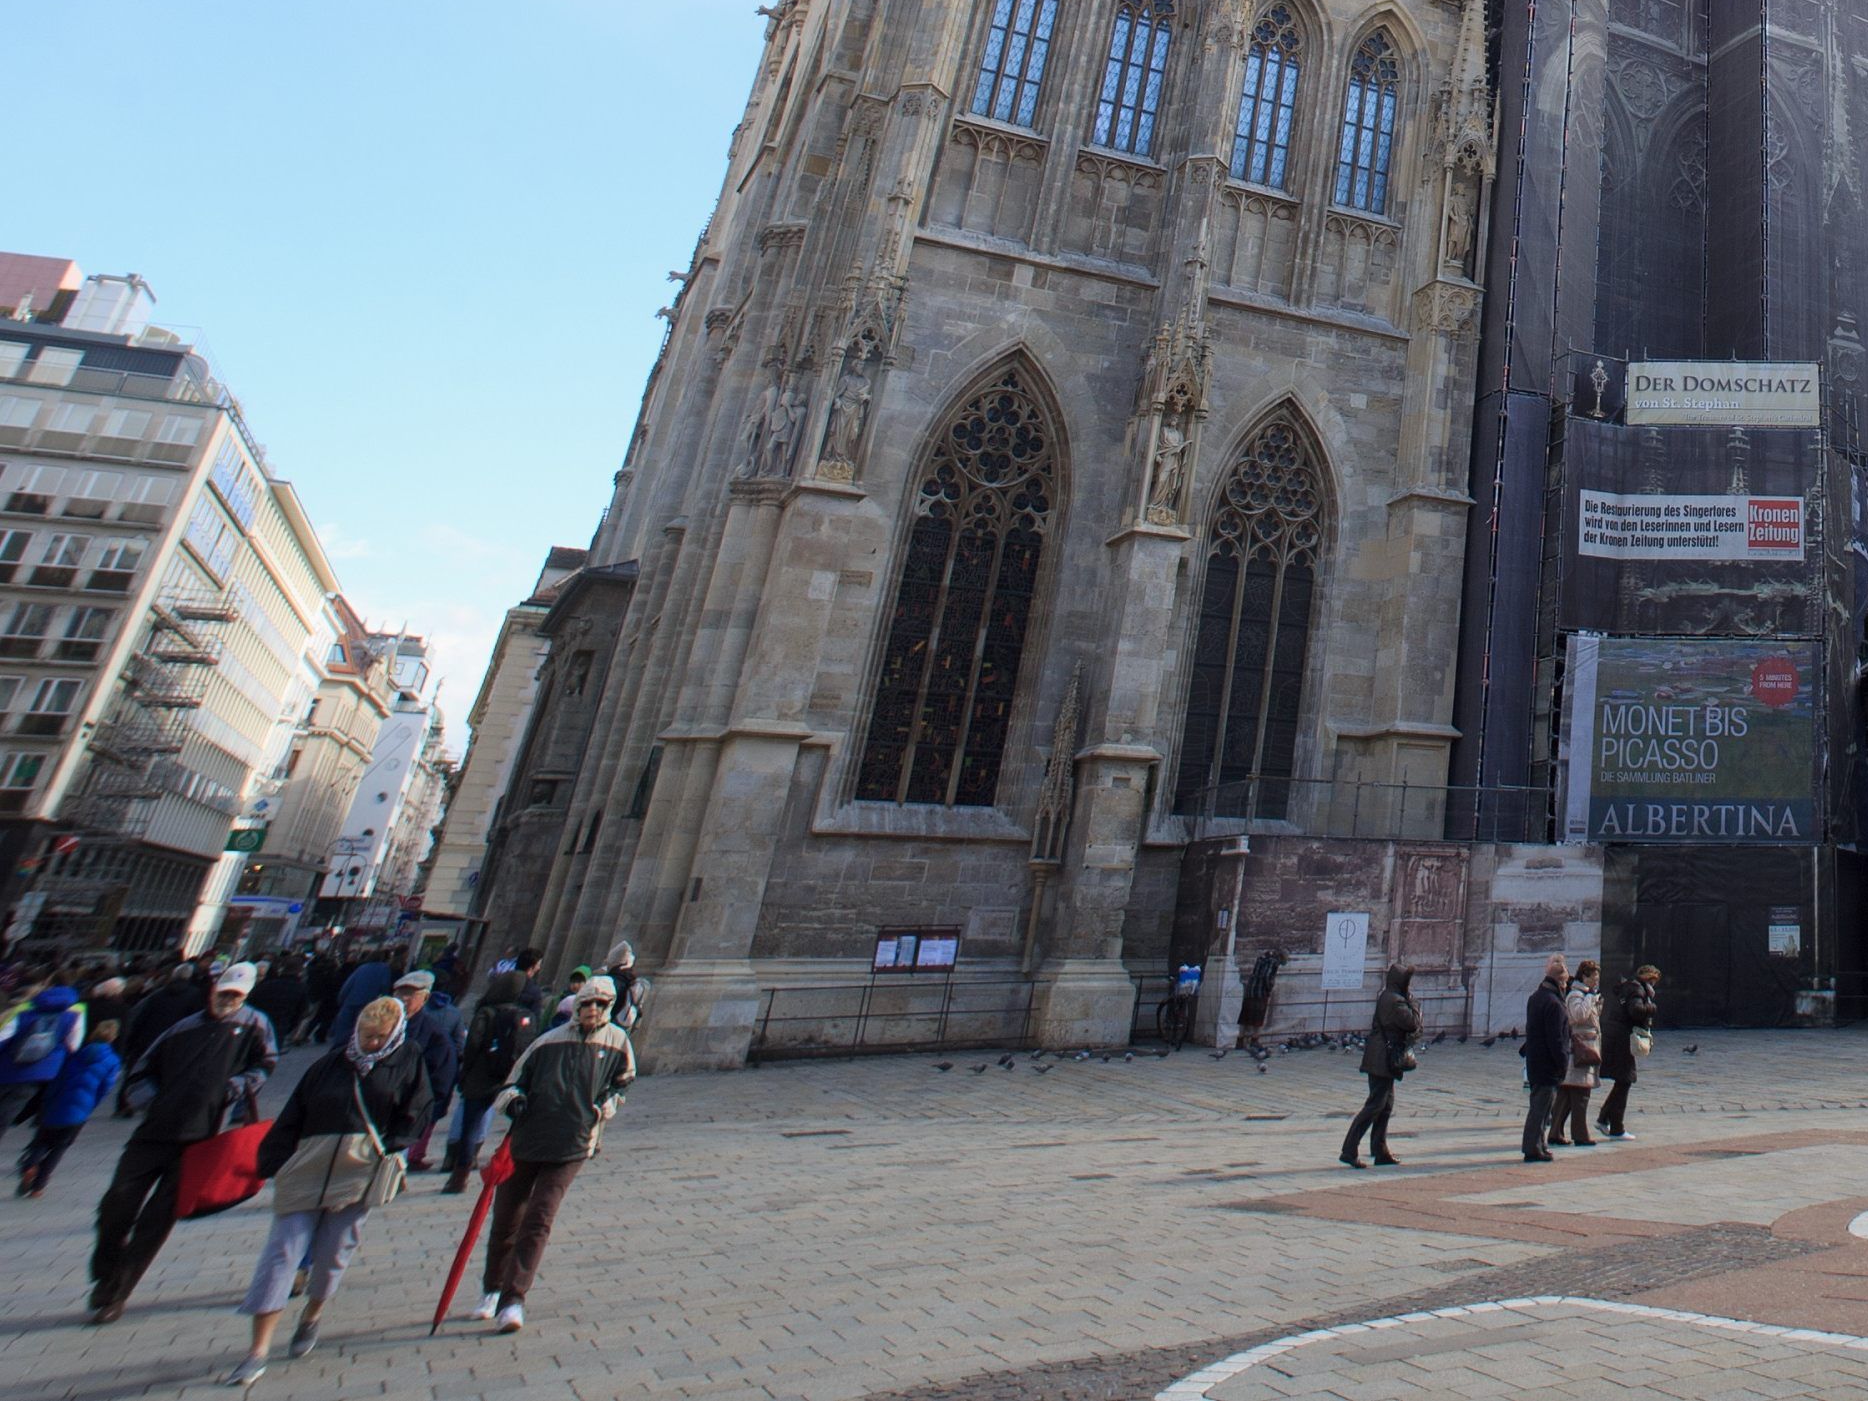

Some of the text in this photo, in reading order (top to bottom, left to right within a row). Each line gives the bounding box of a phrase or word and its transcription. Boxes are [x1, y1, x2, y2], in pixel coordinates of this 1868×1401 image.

[1635, 375, 1811, 393] DER DOMSCHATZ
[1635, 398, 1740, 412] von St. Stephan
[1585, 500, 1737, 519] Die Restaurierung des Singertores
[1750, 505, 1799, 523] Kronen
[1584, 516, 1745, 533] wird von den Leserinnen und Lesern
[1749, 523, 1799, 544] Zeitung
[1584, 531, 1719, 549] der Kronen Zeitung unterstützt!
[1760, 681, 1776, 689] FROM
[1602, 705, 1748, 736] MONET BIS
[1601, 738, 1718, 770] PICASSO
[1600, 772, 1716, 784] DIE SAMMLUNG BATLINER
[1599, 804, 1800, 837] ALBERTINA
